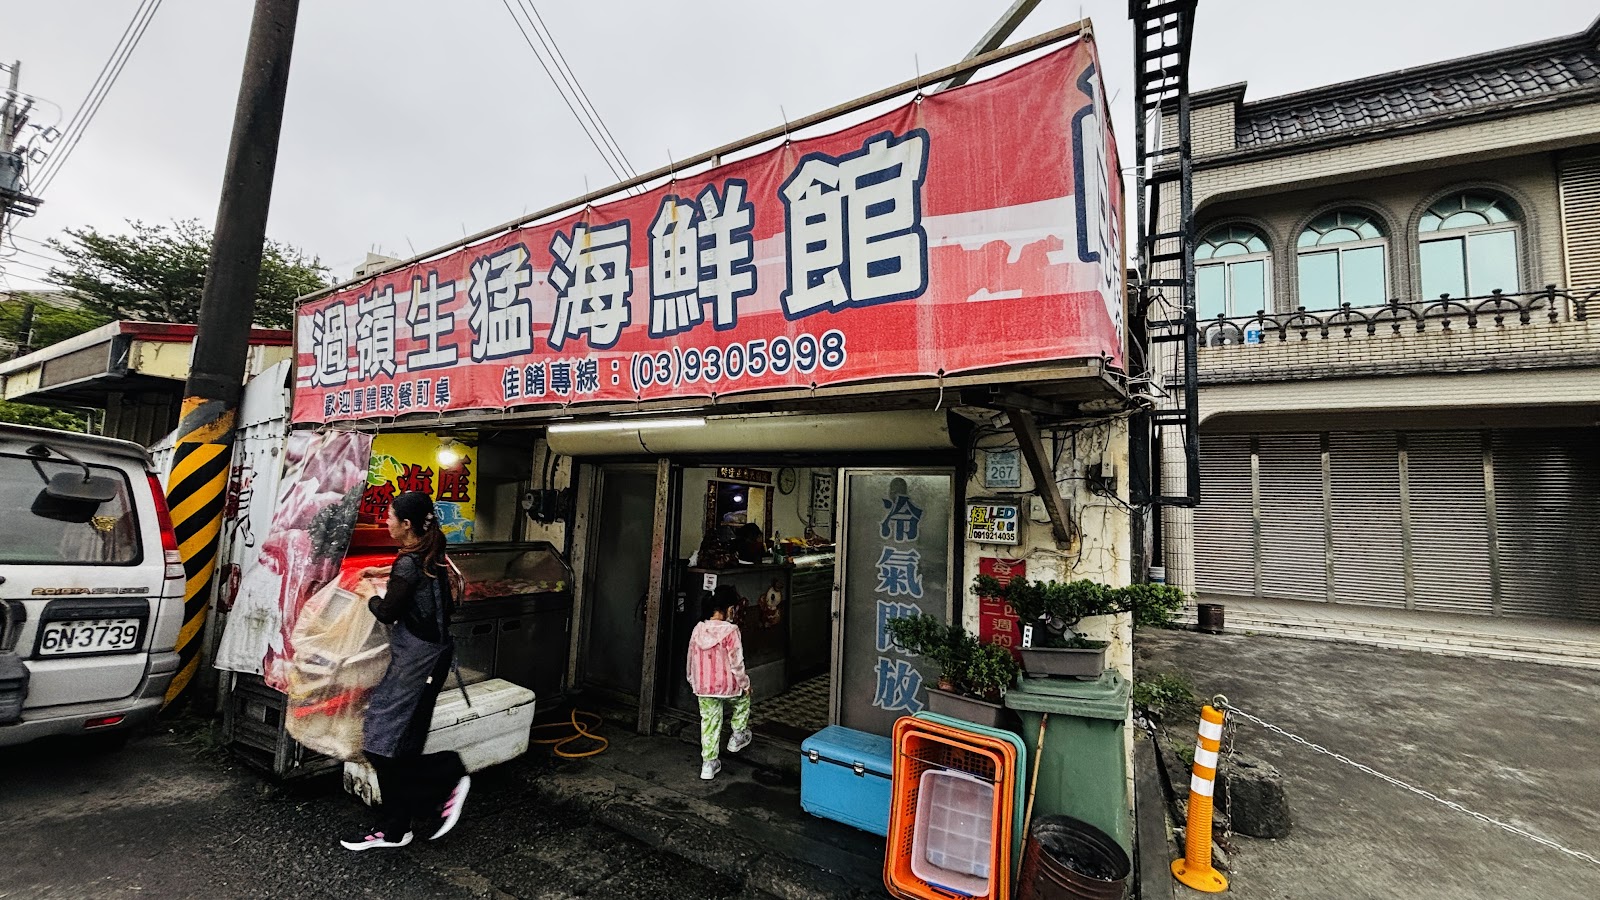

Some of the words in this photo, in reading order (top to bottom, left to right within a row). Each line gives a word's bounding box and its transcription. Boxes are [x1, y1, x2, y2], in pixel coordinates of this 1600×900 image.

[311, 128, 930, 388] 過嶺生猛海鮮館
[630, 330, 846, 392] (03)9305998
[324, 377, 450, 416] 歡迎團體聚餐訂桌
[991, 466, 1014, 479] 267
[989, 507, 1016, 519] LED
[974, 531, 1015, 541] 0919214035
